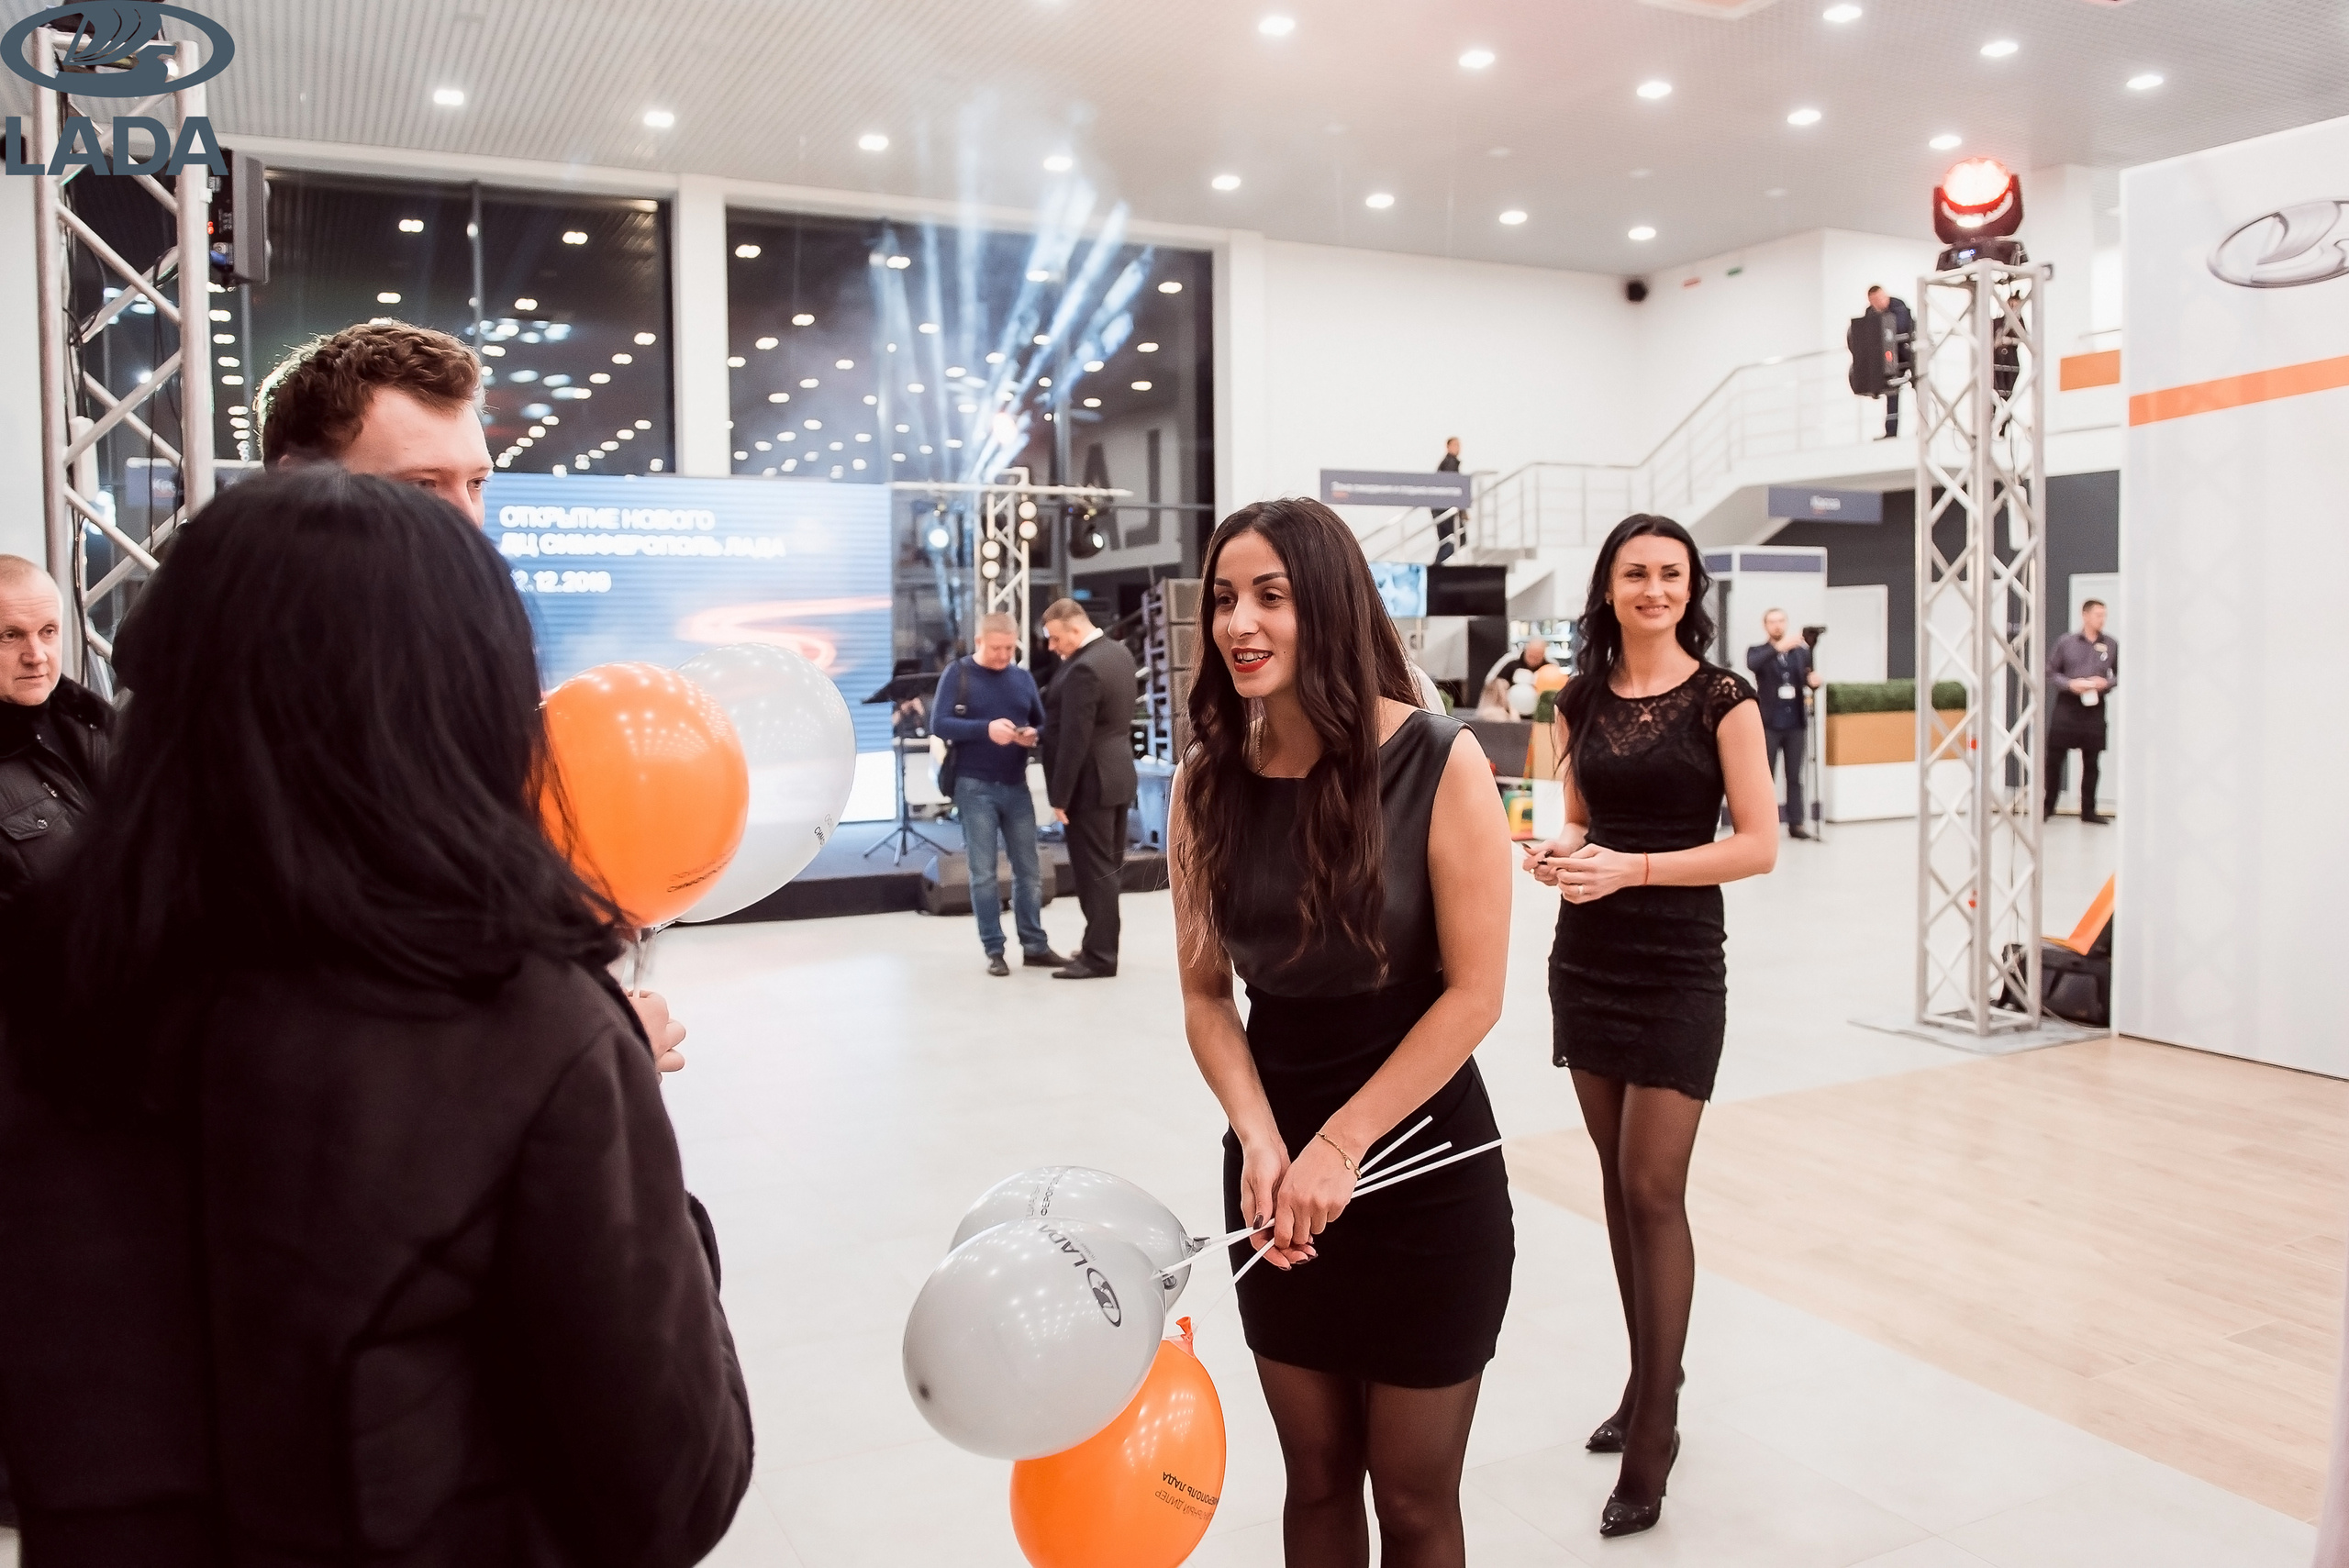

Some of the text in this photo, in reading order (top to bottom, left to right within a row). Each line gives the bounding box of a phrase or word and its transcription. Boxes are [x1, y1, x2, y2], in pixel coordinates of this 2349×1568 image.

[499, 506, 716, 530] ОТКРЫТИЕ НОВОГО
[500, 532, 785, 559] ДЦ СИМФЕРОПОЛЬ ЛАДА
[1038, 1225, 1088, 1268] LADA
[1162, 1471, 1187, 1493] ЛАДА
[1154, 1489, 1186, 1510] ДИЛЕР
